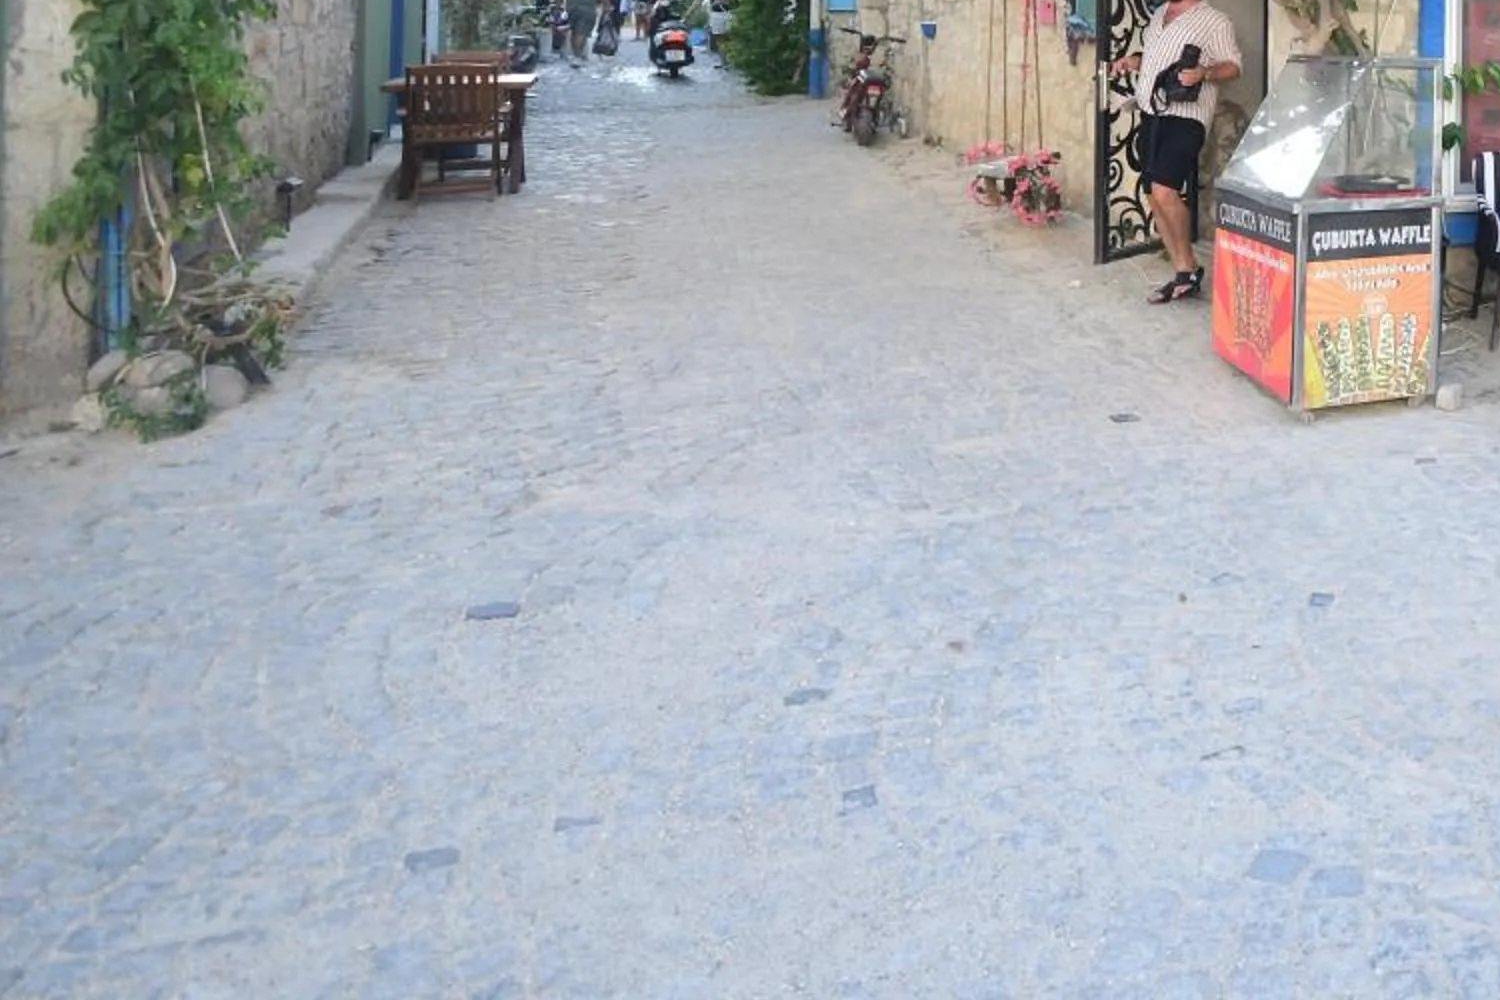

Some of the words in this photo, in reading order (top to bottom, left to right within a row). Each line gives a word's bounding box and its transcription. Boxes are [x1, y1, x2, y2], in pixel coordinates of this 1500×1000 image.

[1259, 214, 1292, 243] WAFFLE
[1312, 229, 1377, 256] ÇUBUKTA
[1379, 224, 1432, 247] WAFFLE
